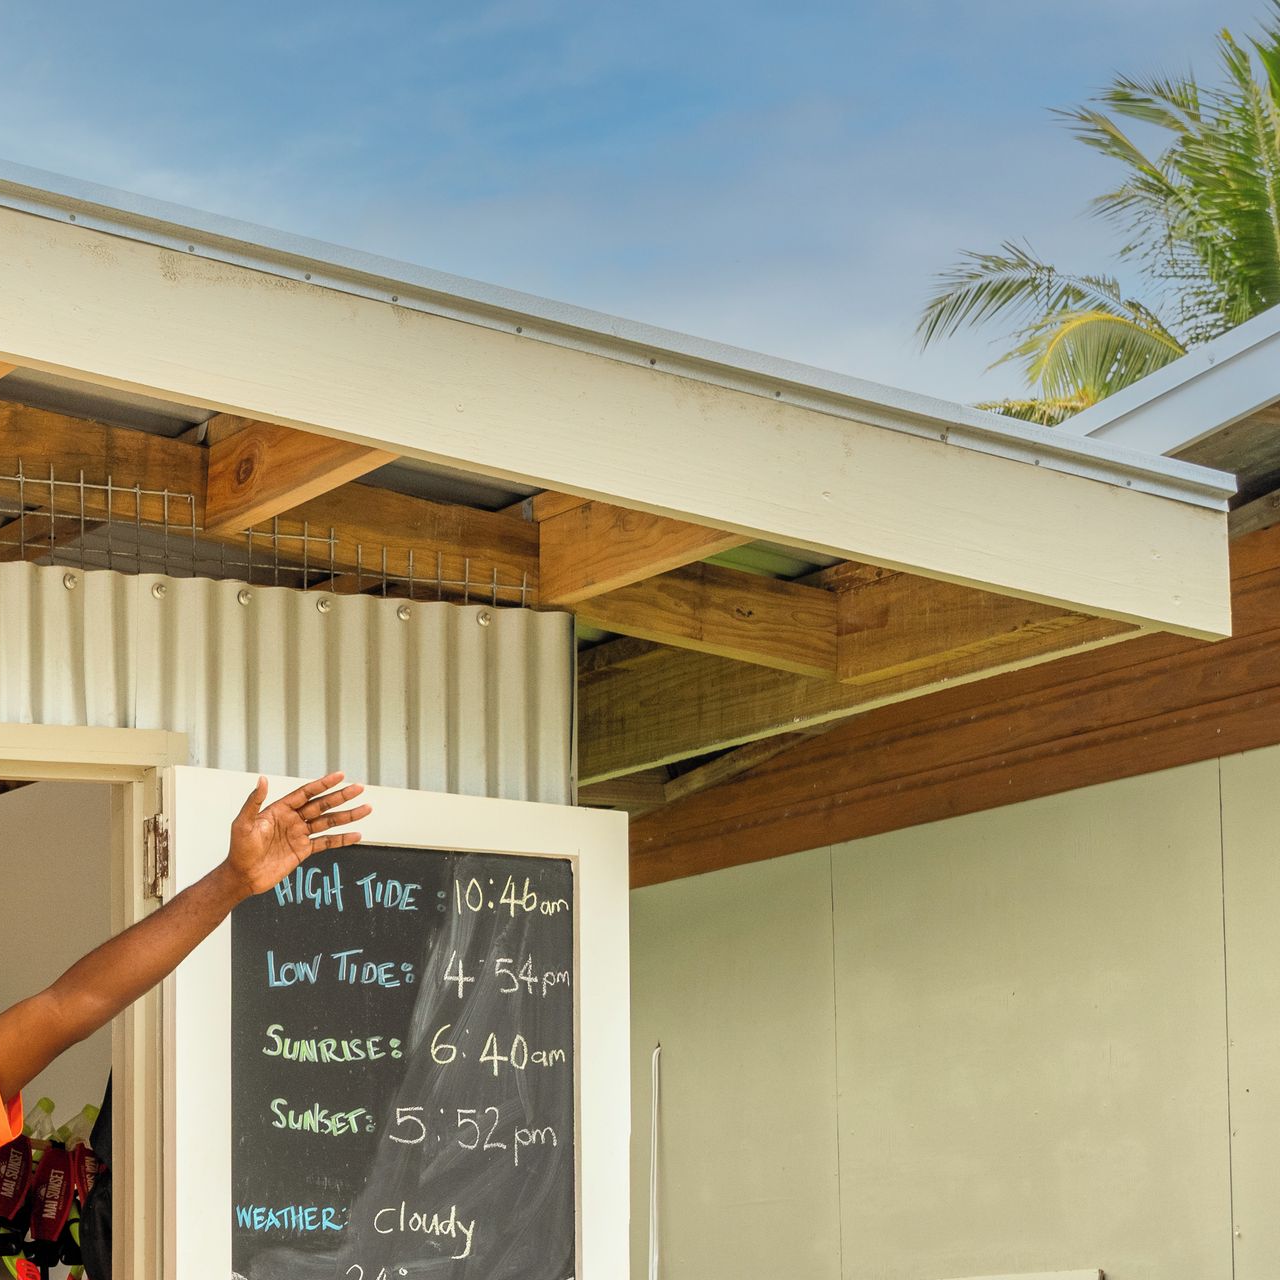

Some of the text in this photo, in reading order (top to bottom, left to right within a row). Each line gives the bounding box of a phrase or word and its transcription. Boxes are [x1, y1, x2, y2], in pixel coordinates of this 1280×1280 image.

[273, 863, 343, 911] HIGH
[267, 950, 322, 987] LOW
[331, 949, 414, 988] TIDE:
[263, 1024, 402, 1063] SUNRISE:
[270, 1098, 376, 1136] SUNSET:
[5, 1147, 24, 1179] SUNSET
[0, 1179, 17, 1198] MAI
[46, 1168, 66, 1202] SUNSET
[42, 1201, 59, 1219] MAI
[236, 1201, 476, 1260] WEATHER: Cloudy
